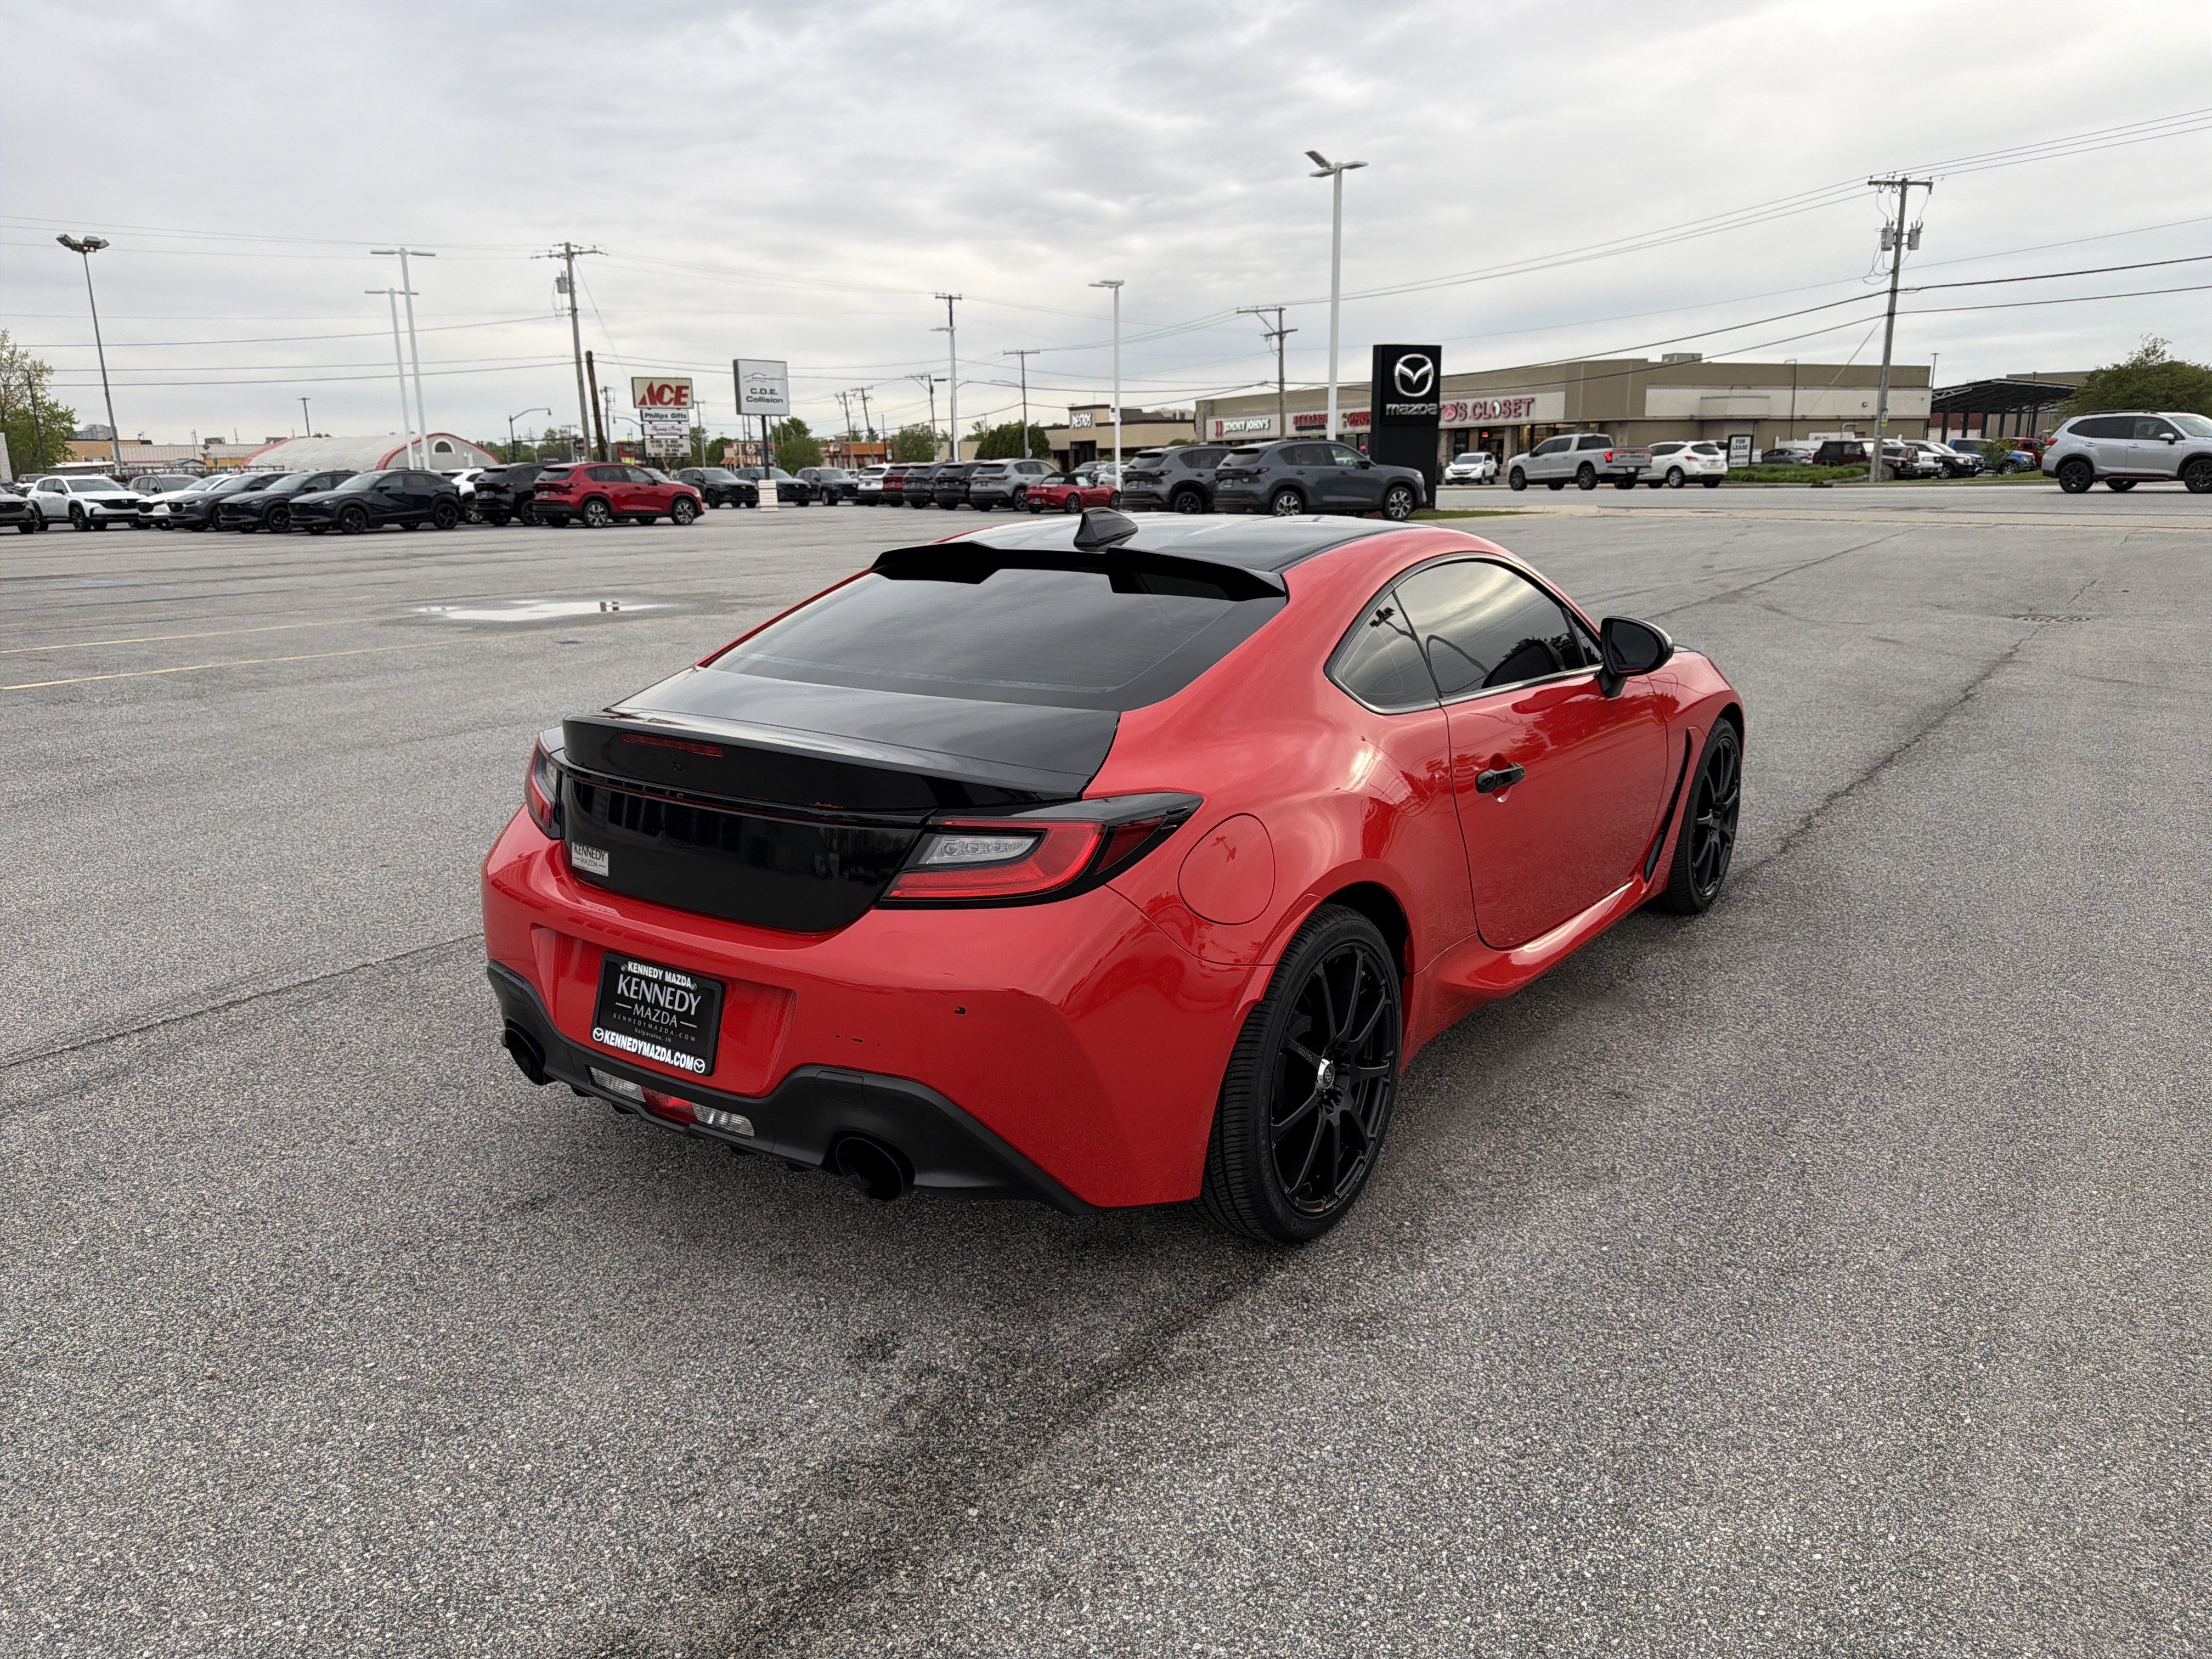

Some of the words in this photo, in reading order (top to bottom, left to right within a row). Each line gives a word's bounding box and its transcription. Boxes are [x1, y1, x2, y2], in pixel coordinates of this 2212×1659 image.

[638, 380, 690, 406] ACE
[746, 396, 784, 404] Collision
[750, 387, 778, 396] C.D.E.
[1471, 398, 1535, 420] CLOSET
[574, 843, 606, 862] KENNEDY
[580, 857, 598, 868] MAZDA
[628, 961, 664, 980] KENNEDY
[664, 970, 692, 988] MAZDA
[617, 973, 702, 1015] KENNEDY
[613, 1012, 696, 1042] KENNEDYMAZDA.COM
[633, 1003, 678, 1028] MAZDA
[634, 1026, 664, 1042] Valparaiso,
[603, 1030, 695, 1071] KENNEDYMAZDA.COM
